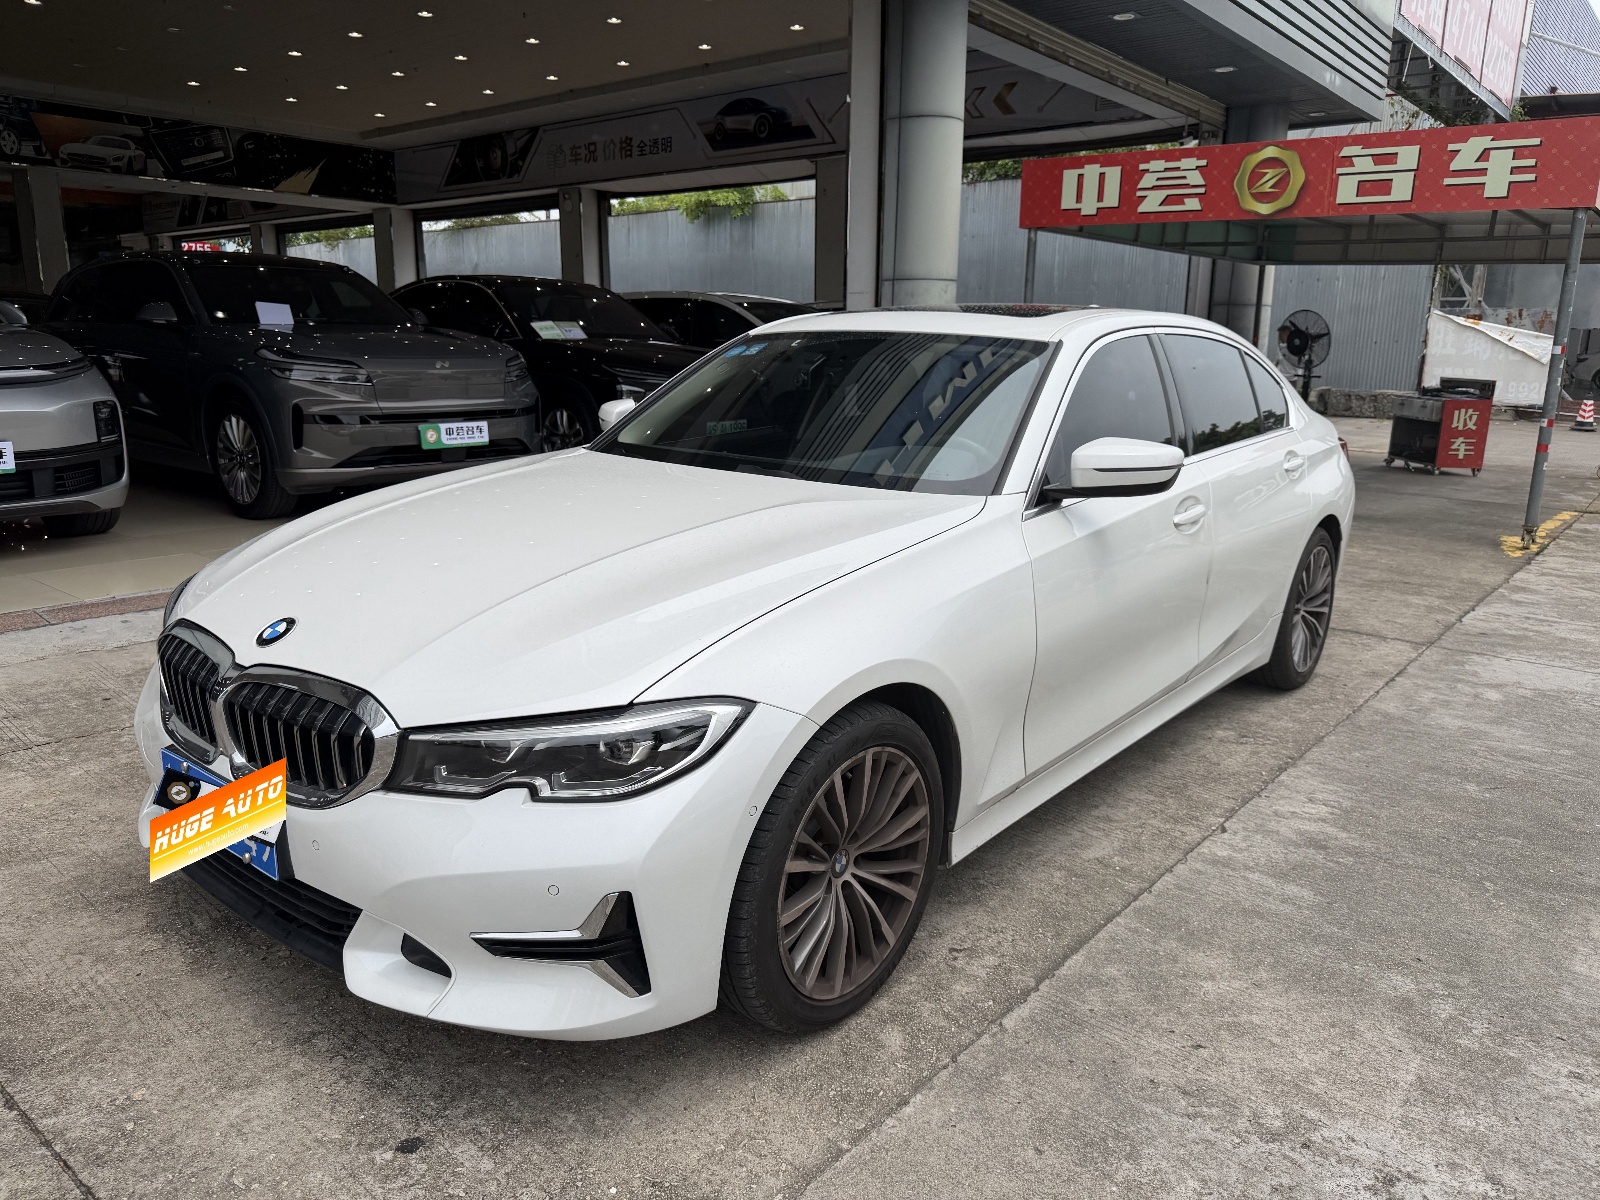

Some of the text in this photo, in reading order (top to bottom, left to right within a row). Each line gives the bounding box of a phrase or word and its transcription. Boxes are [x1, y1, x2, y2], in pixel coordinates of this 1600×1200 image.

[1061, 158, 1207, 215] 中荟
[1336, 136, 1541, 204] 名车
[445, 425, 485, 437] 中荟名车
[1448, 408, 1480, 460] 收车
